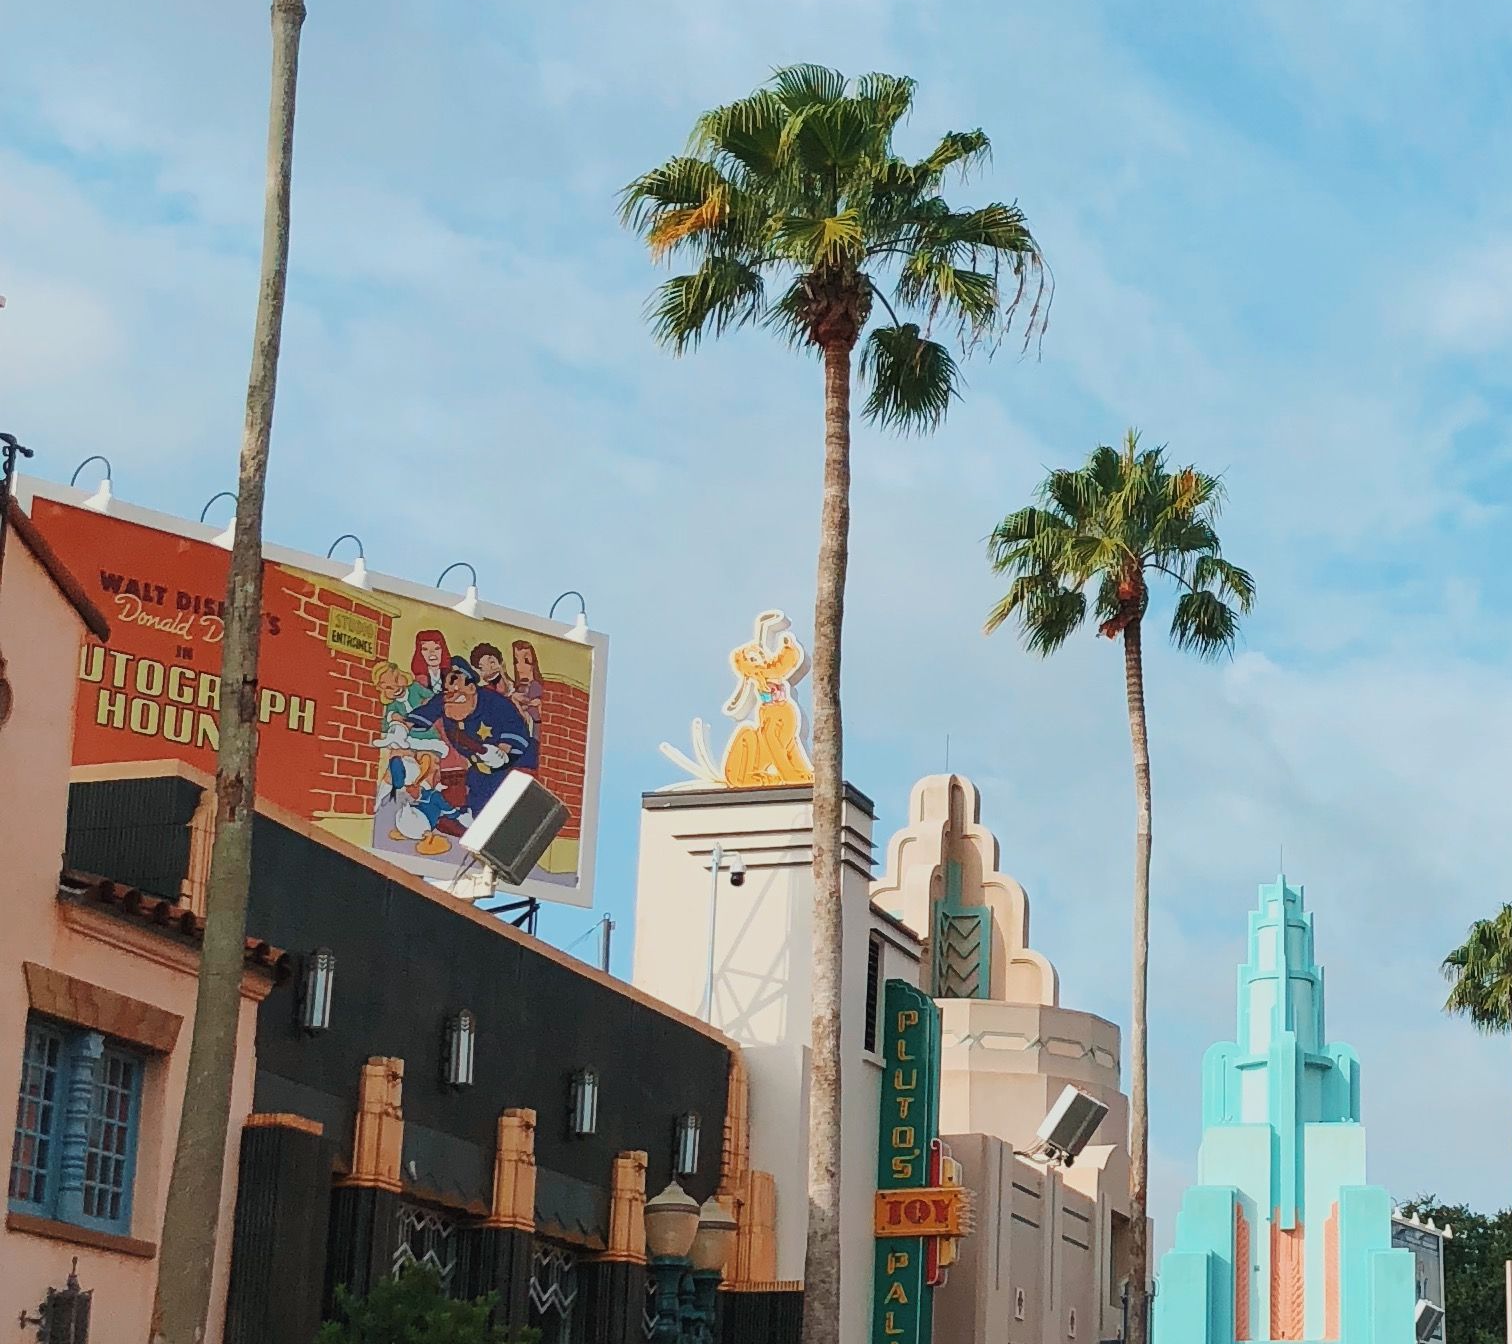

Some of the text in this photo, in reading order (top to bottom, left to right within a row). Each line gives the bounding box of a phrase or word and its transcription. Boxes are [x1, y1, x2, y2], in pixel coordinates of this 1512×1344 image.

[100, 570, 167, 606] WALT
[115, 594, 193, 640] Donald
[176, 645, 193, 661] IN
[332, 629, 373, 655] ENTRANCE
[97, 689, 220, 752] HOUN
[892, 1010, 921, 1179] PLUTO'S
[886, 1199, 953, 1226] TOY
